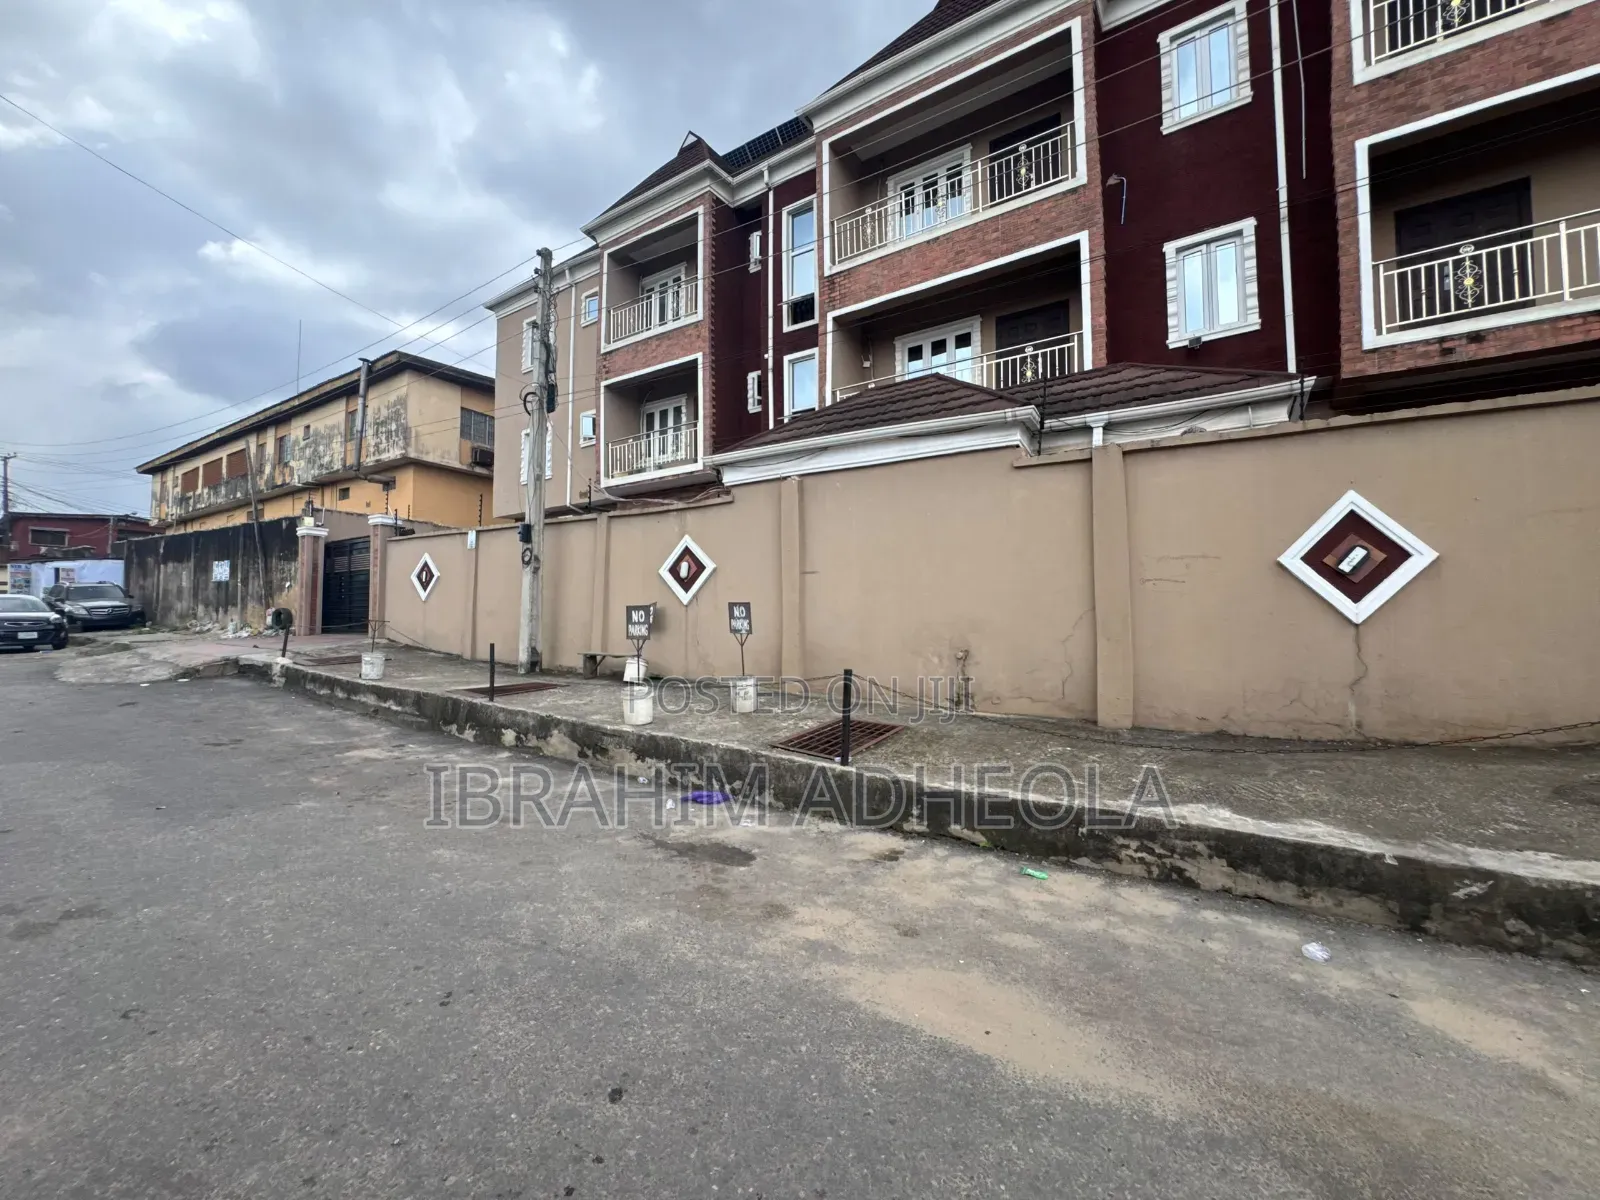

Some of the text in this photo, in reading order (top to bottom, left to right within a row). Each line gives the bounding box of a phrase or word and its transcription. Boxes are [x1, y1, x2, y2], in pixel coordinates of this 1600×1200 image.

[631, 609, 645, 623] NO
[732, 605, 746, 618] NO
[628, 624, 649, 636] PARKING
